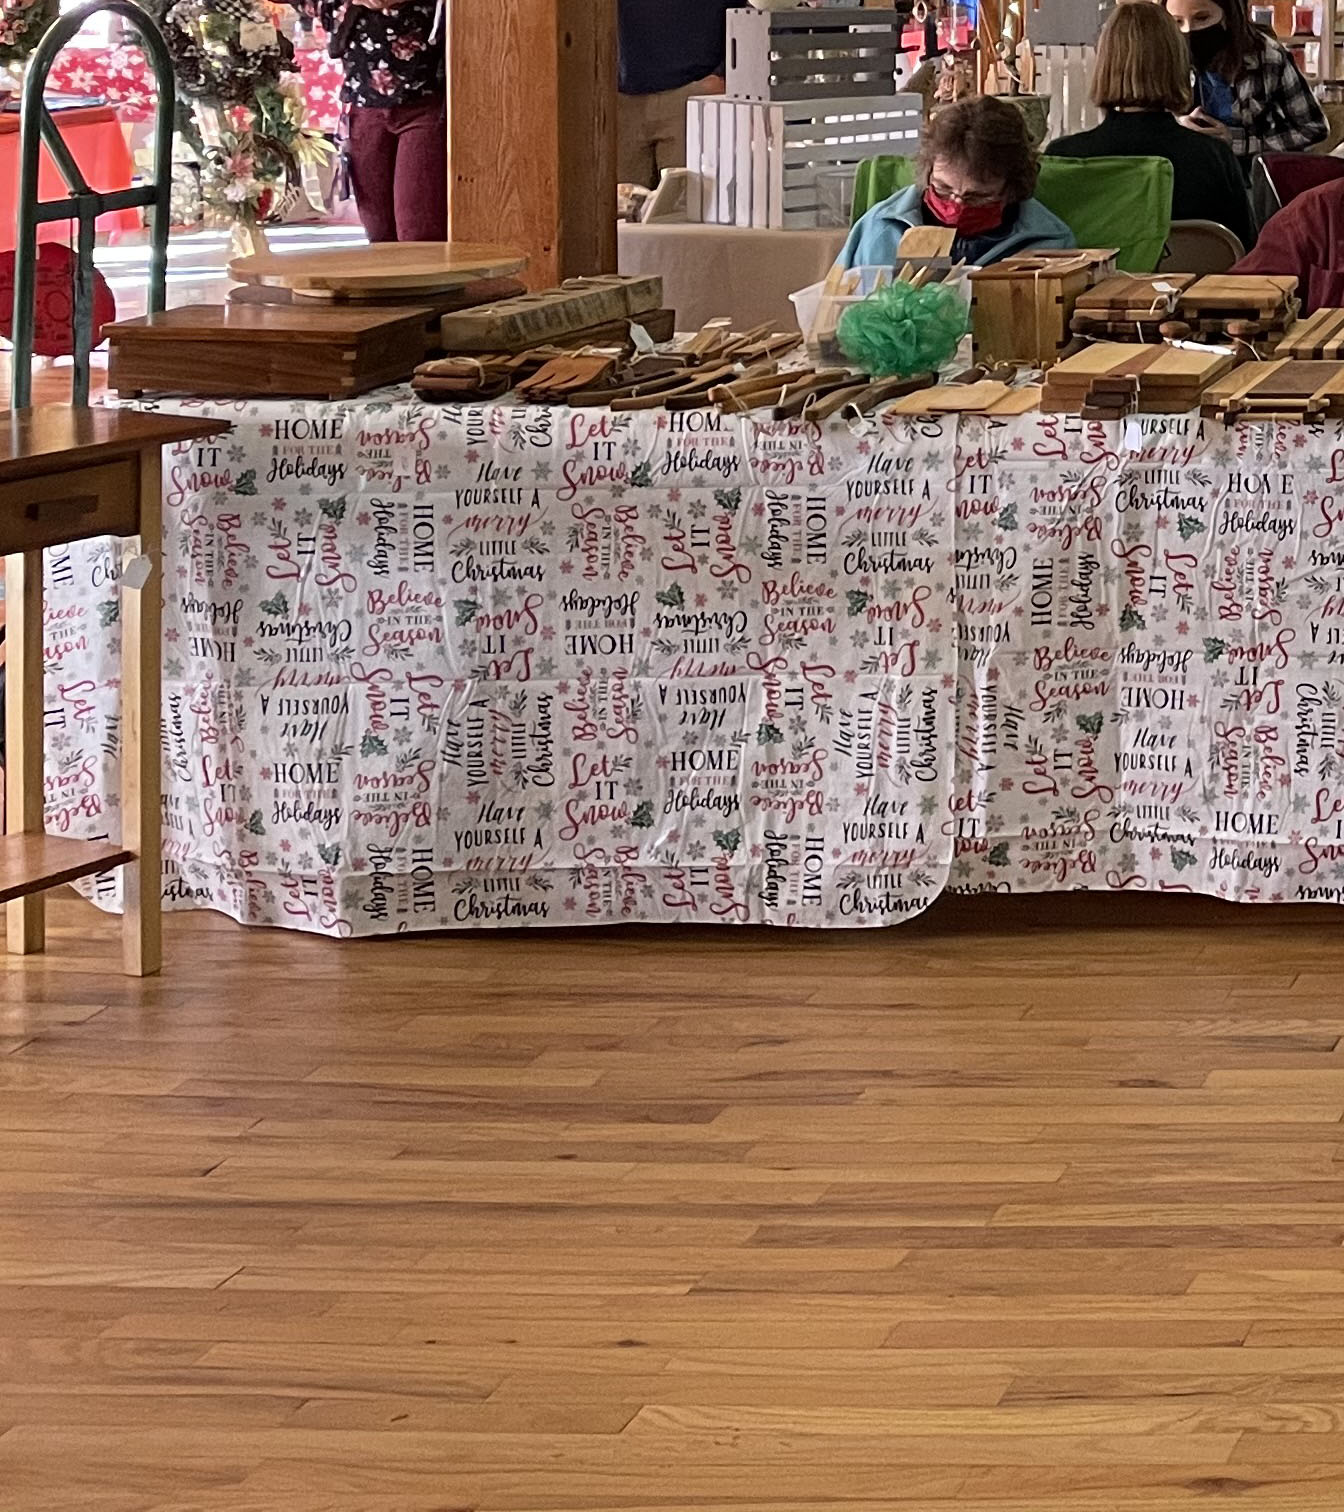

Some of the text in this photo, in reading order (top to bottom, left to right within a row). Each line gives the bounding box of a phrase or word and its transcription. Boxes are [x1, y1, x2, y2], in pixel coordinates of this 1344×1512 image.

[274, 418, 344, 439] HOME
[566, 413, 614, 450] Let
[197, 448, 221, 467] IT
[593, 442, 616, 460] IT
[661, 450, 741, 478] Holidays
[867, 455, 914, 474] Have
[266, 457, 347, 485] Holidays
[476, 461, 523, 482] Have
[556, 460, 630, 501] Snow
[1144, 469, 1180, 485] LITTLE
[167, 466, 234, 507] Snow
[455, 488, 540, 509] YOURSELF A
[847, 480, 930, 501] YOURSELF A
[1116, 487, 1208, 513] Christmas
[367, 498, 398, 577] Holidays
[413, 504, 434, 573] HOME
[691, 525, 710, 547] IT
[761, 489, 791, 571] Holidays
[807, 497, 826, 565] HOME
[871, 532, 906, 547] LITTLE
[1218, 510, 1296, 541] Holidays
[297, 532, 316, 556] IT
[479, 541, 516, 555] LITTLE
[571, 503, 605, 582] Season
[613, 505, 646, 582] Believe
[710, 512, 751, 584] Snow
[451, 550, 546, 583] Christmas
[843, 548, 934, 575] Christmas
[1111, 539, 1152, 608] Snow
[762, 572, 837, 604] Believe
[1032, 558, 1053, 625] HOME
[1069, 552, 1100, 630] Holidays
[1149, 576, 1166, 598] IT
[1212, 545, 1244, 621] Believe
[1252, 548, 1282, 625] Season
[367, 581, 445, 614] Believe
[561, 589, 639, 617] Holidays
[780, 606, 824, 616] IN THE
[867, 585, 931, 628] Snow
[387, 616, 431, 625] IN THE
[476, 593, 543, 636] Snow
[363, 624, 444, 657] Season
[759, 613, 836, 645] Season
[874, 627, 893, 645] IT
[482, 635, 506, 654] IT
[564, 634, 633, 656] HOME
[1054, 669, 1098, 680] IN THE
[1236, 666, 1257, 685] IT
[390, 697, 410, 720] IT
[564, 666, 598, 742] Believe
[606, 666, 639, 744] Season
[785, 687, 804, 709] IT
[1030, 680, 1110, 711] Season
[1122, 688, 1184, 710] HOME
[529, 694, 555, 788] Christmas
[910, 688, 938, 781] Christmas
[1133, 728, 1177, 749] Have
[1295, 683, 1322, 777] Christmas
[274, 762, 340, 784] HOME
[569, 753, 615, 789] Let
[671, 749, 738, 771] HOME
[752, 749, 828, 781] Season
[1114, 752, 1192, 778] YOURSELF A
[355, 760, 435, 792] Season
[595, 782, 618, 800] IT
[664, 788, 740, 818] Holidays
[271, 801, 343, 831] Holidays
[352, 802, 431, 837] Believe
[477, 801, 524, 825] Have
[752, 791, 824, 824] Believe
[865, 794, 908, 817] Have
[1136, 805, 1170, 821] LITTLE
[558, 799, 632, 841] Snow
[843, 823, 925, 844] YOURSELF A
[1215, 811, 1279, 835] HOME
[455, 828, 543, 852] YOURSELF A
[1110, 823, 1196, 846] Christmas
[759, 830, 787, 910] Holidays
[802, 837, 824, 906] HOME
[1209, 848, 1282, 878] Holidays
[363, 843, 393, 920] Holidays
[411, 848, 436, 914] HOME
[484, 878, 520, 892] LITTLE
[867, 874, 902, 888] LITTLE
[454, 894, 550, 922] Christmas
